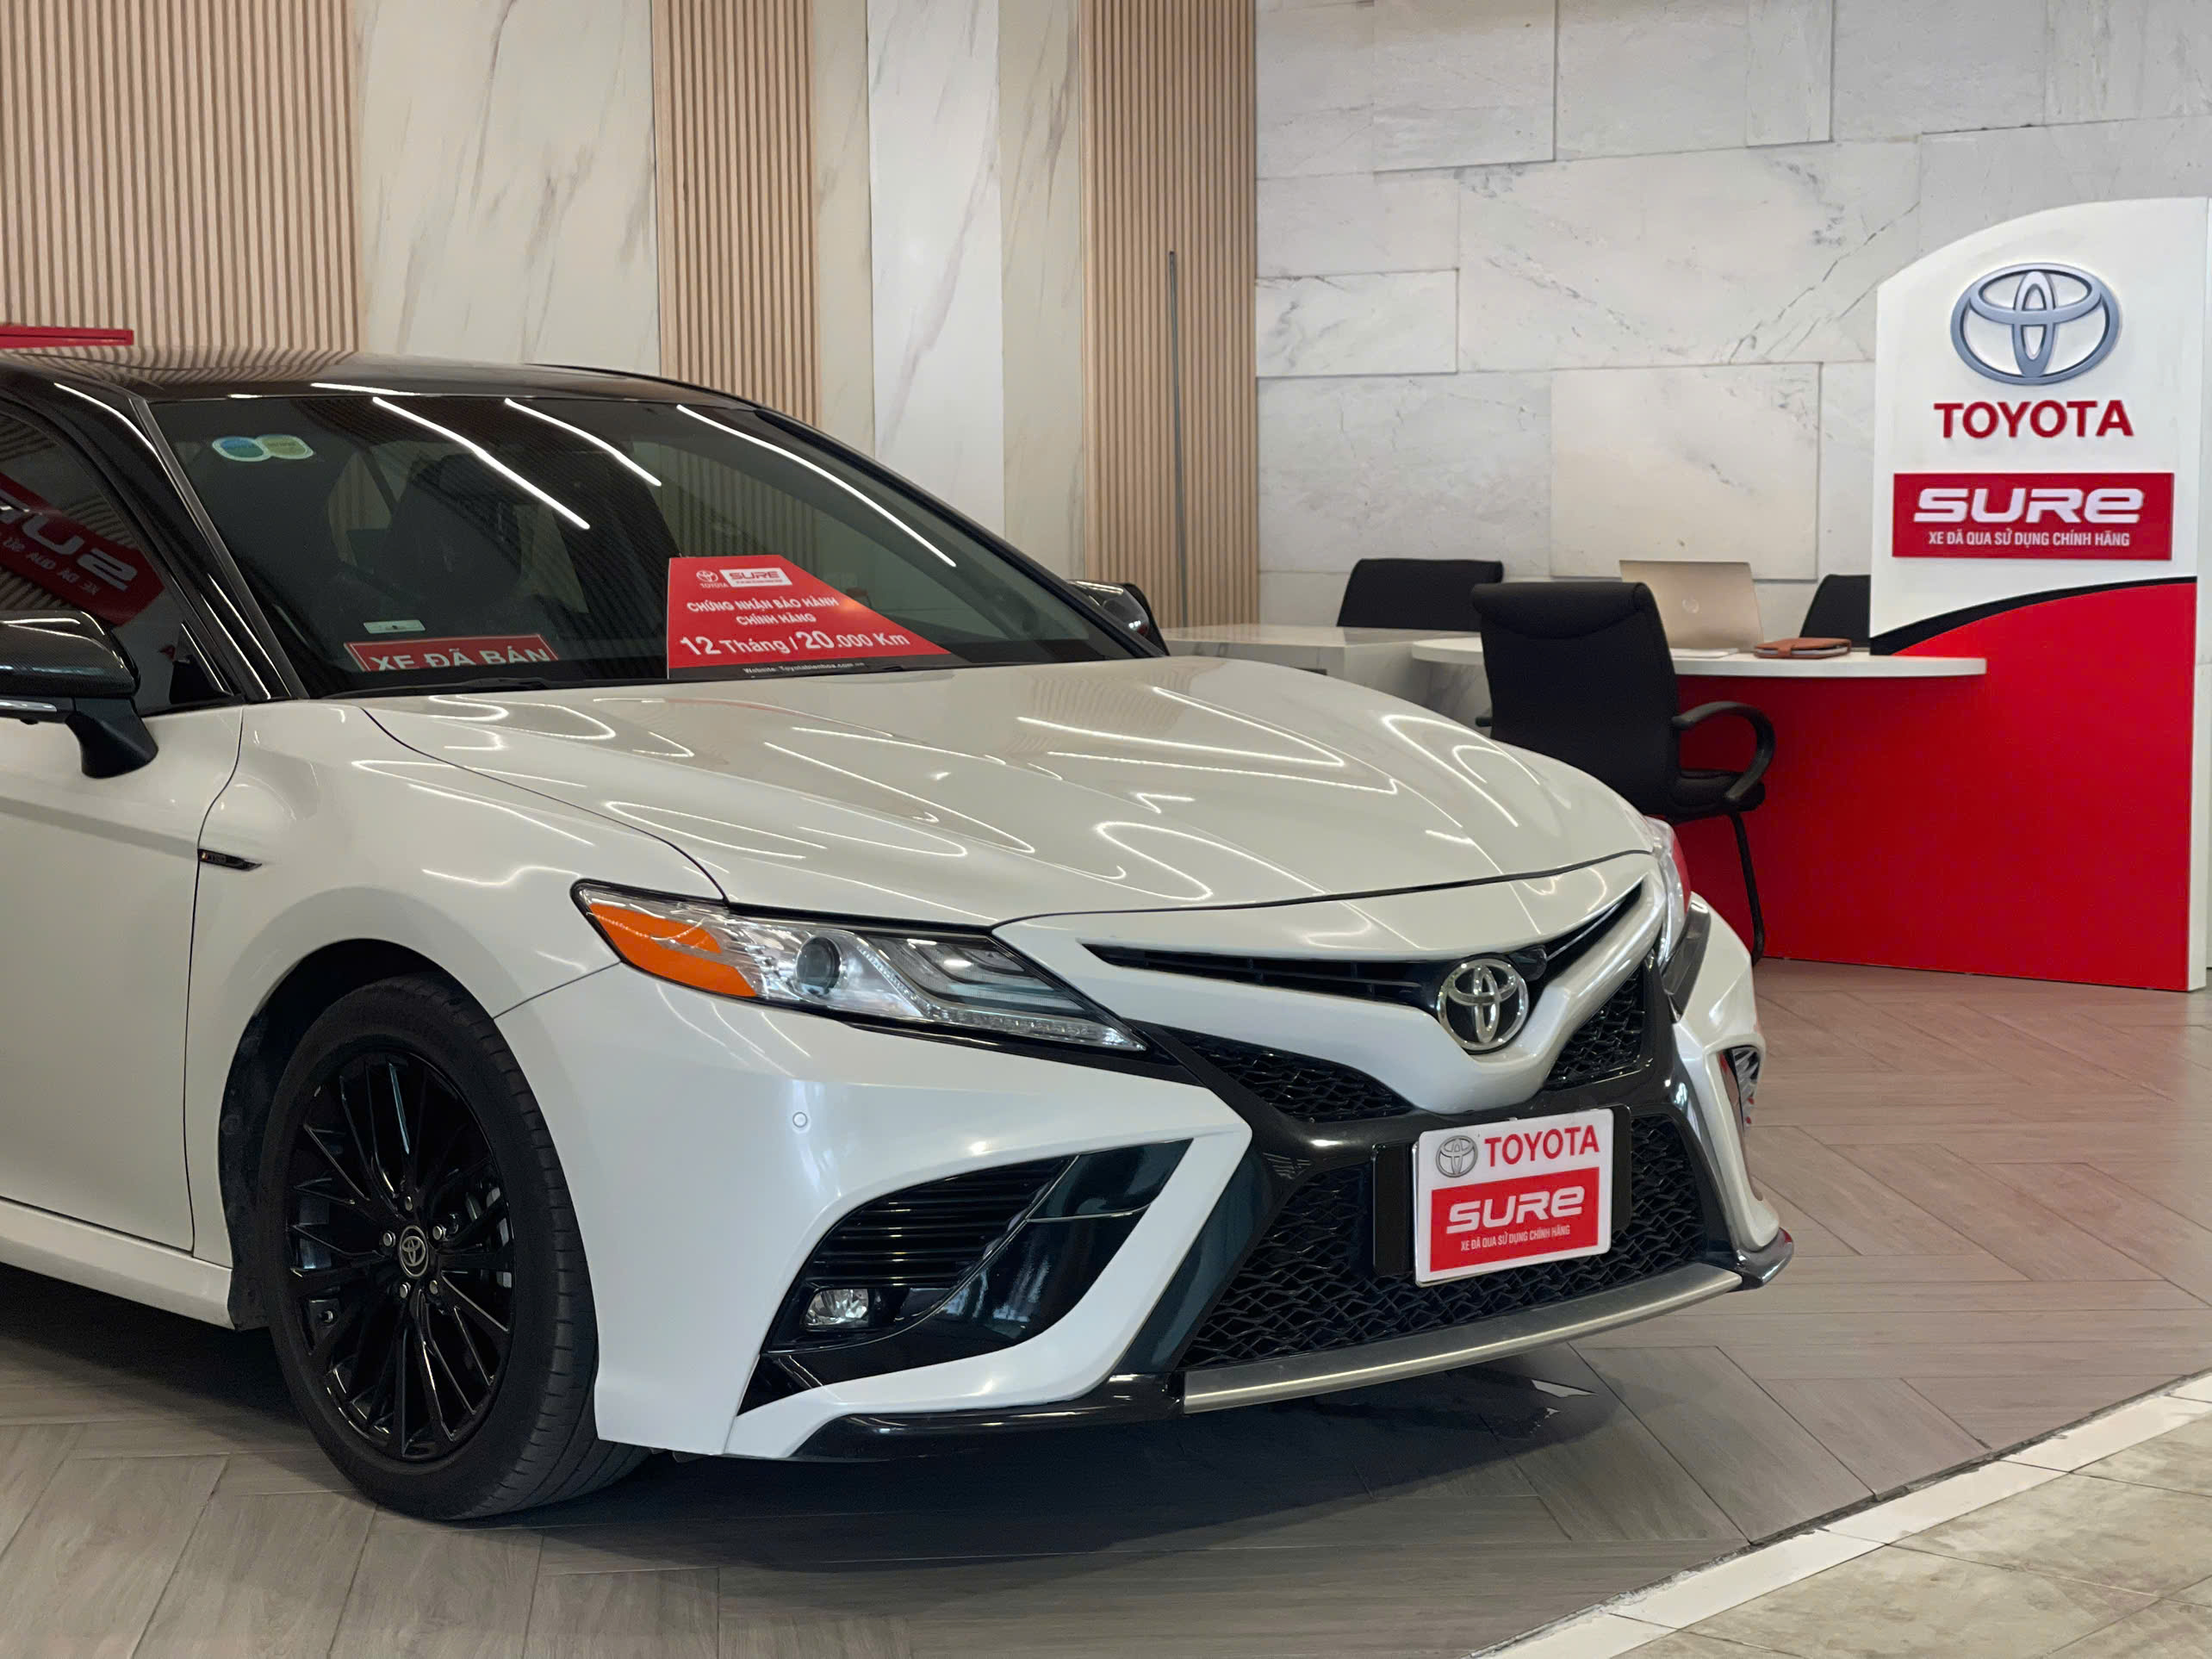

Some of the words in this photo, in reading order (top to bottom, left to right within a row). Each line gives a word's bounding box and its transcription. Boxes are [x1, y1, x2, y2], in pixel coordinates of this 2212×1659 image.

[1933, 400, 2134, 438] TOYOTA
[1929, 531, 1944, 545] XE
[1947, 529, 1963, 545] ĐÃ
[1967, 531, 1991, 545] QUA
[1994, 527, 2013, 545] SỬ
[2014, 531, 2049, 548] DỤNG
[2053, 528, 2091, 546] CHÍNH
[2094, 530, 2130, 547] HÃNG
[687, 599, 735, 612] CHỨNG
[734, 597, 774, 612] NHẬN
[773, 595, 801, 609] BẢO
[800, 595, 839, 608] HÀNH
[736, 613, 779, 625] CHÍNH
[680, 635, 722, 656] 12
[719, 637, 791, 655] Tháng
[872, 632, 910, 645] Km
[369, 654, 419, 671] XE
[424, 648, 475, 668] ĐÃ
[479, 646, 550, 665] BÁN
[1484, 1125, 1600, 1167] TOYOTA
[1461, 1240, 1470, 1252] XE
[1482, 1237, 1497, 1248] QUA
[1530, 1229, 1550, 1240] CHÍNH
